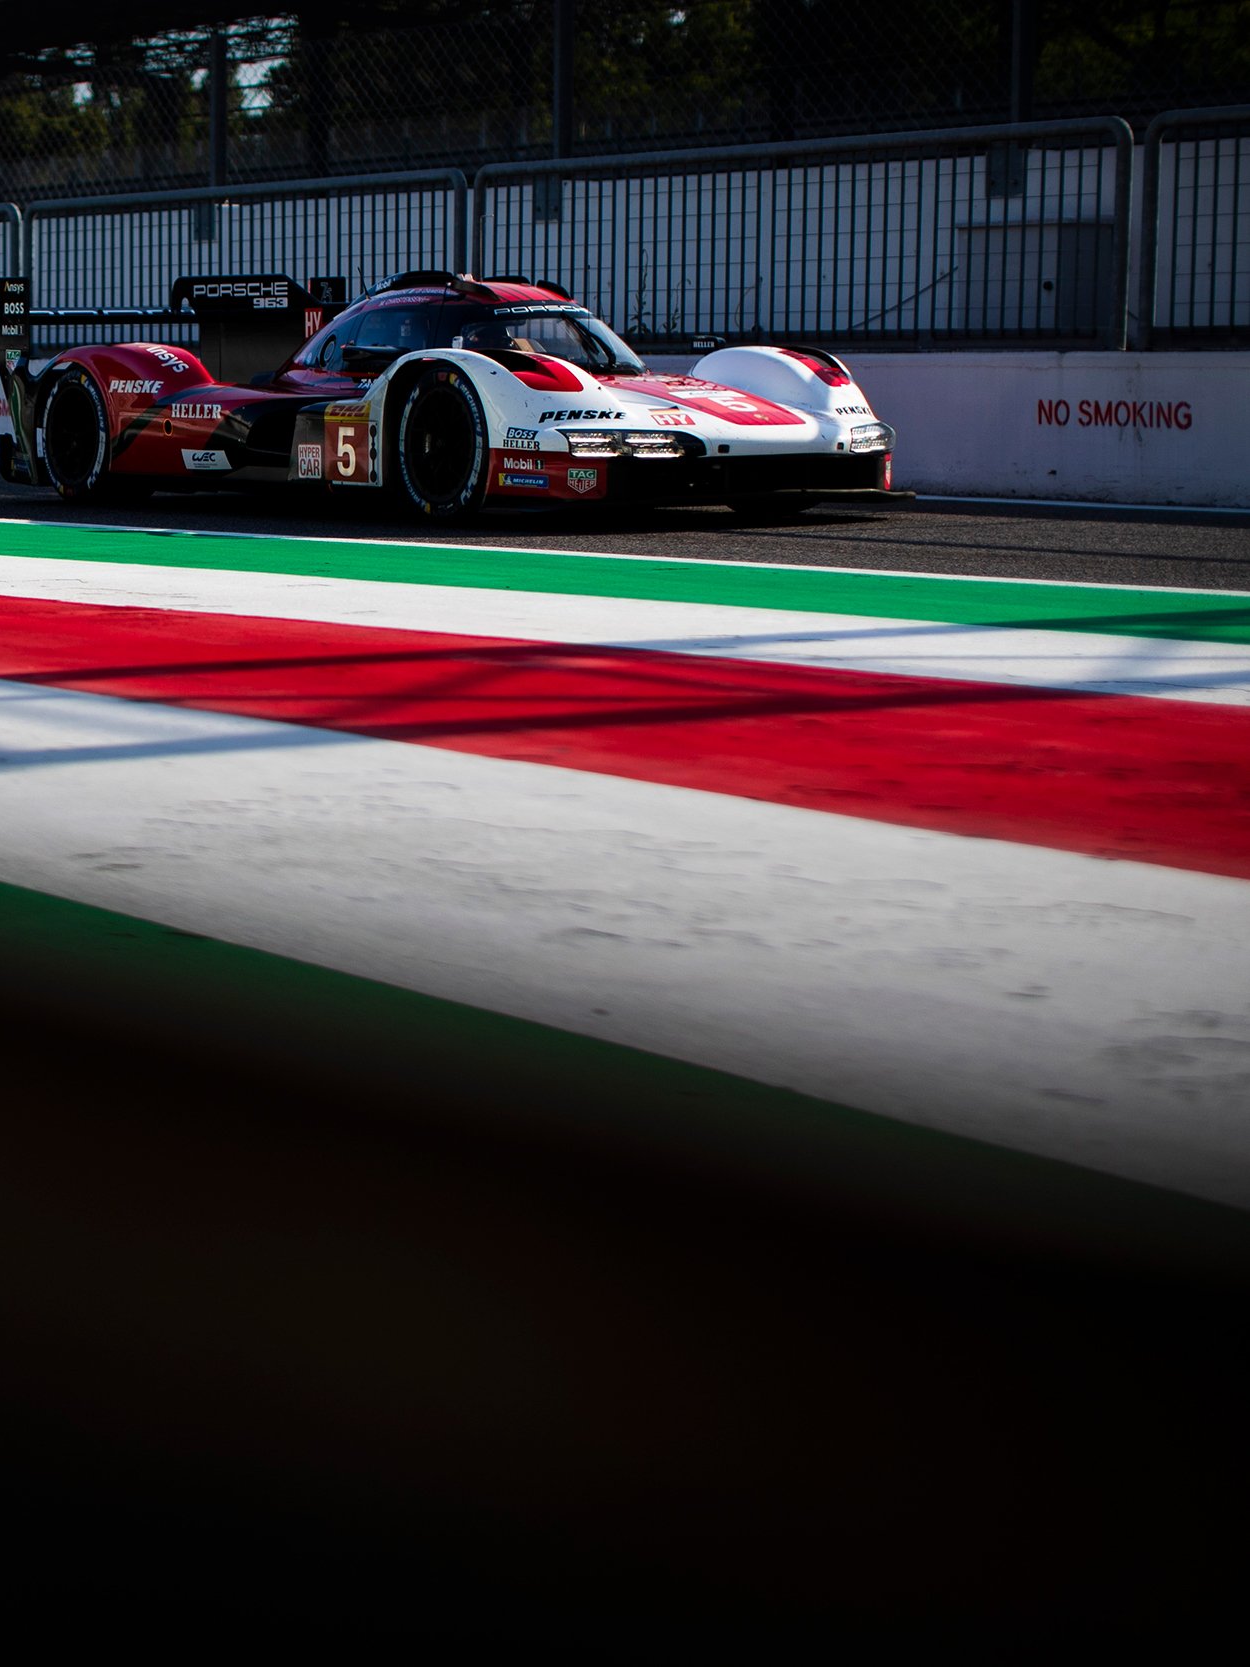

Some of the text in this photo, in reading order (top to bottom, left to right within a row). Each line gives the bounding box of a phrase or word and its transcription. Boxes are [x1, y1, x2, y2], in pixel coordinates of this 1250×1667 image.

[3, 281, 25, 294] Ansys
[193, 282, 289, 298] PORSCHE
[3, 302, 25, 315] BOSS
[253, 297, 289, 309] 963
[1, 325, 19, 336] Mobil
[304, 311, 323, 338] HY
[108, 379, 165, 393] PENSKE
[171, 403, 222, 419] HELLER
[706, 396, 758, 413] 5
[538, 409, 627, 423] PENSKE
[652, 414, 692, 425] HY
[1037, 399, 1193, 430] NO SMOKING
[507, 429, 535, 439] BOSS
[502, 439, 541, 450] HELLER
[192, 452, 216, 462] WEC
[299, 446, 321, 459] HYPER
[336, 426, 357, 478] 5
[299, 458, 321, 477] CAR
[503, 457, 533, 470] Mobil
[512, 477, 544, 485] MICHELIN
[570, 470, 594, 479] TAG
[569, 479, 597, 492] HEUER
